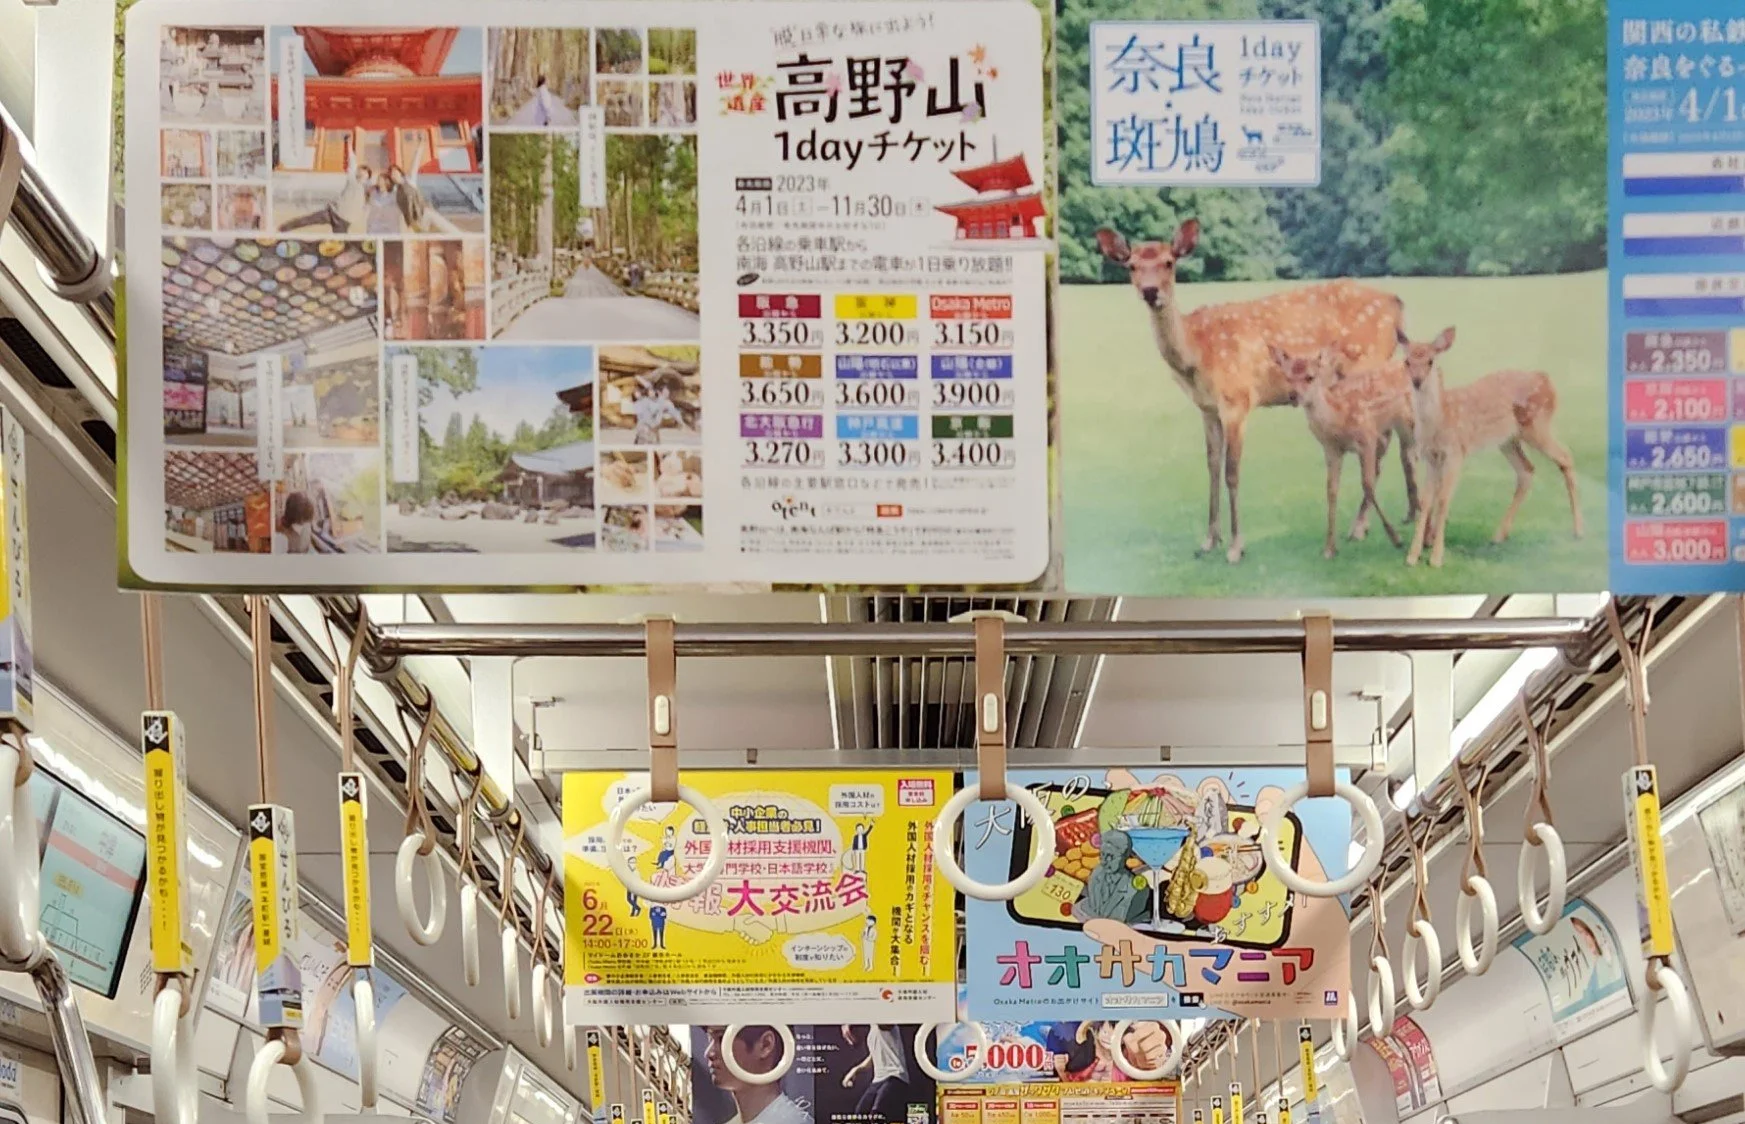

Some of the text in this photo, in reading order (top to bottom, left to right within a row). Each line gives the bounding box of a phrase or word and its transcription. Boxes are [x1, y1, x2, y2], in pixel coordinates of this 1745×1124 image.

[1105, 33, 1223, 94] 奈良
[1239, 35, 1301, 61] 1day
[775, 53, 987, 124] 高野山
[1239, 66, 1302, 88] チケット
[774, 129, 977, 170] 1dayチケット
[1105, 113, 1226, 173] 斑鳩
[684, 840, 837, 856] 外国材採用支援機関、
[996, 939, 1315, 989] オオサカマニア
